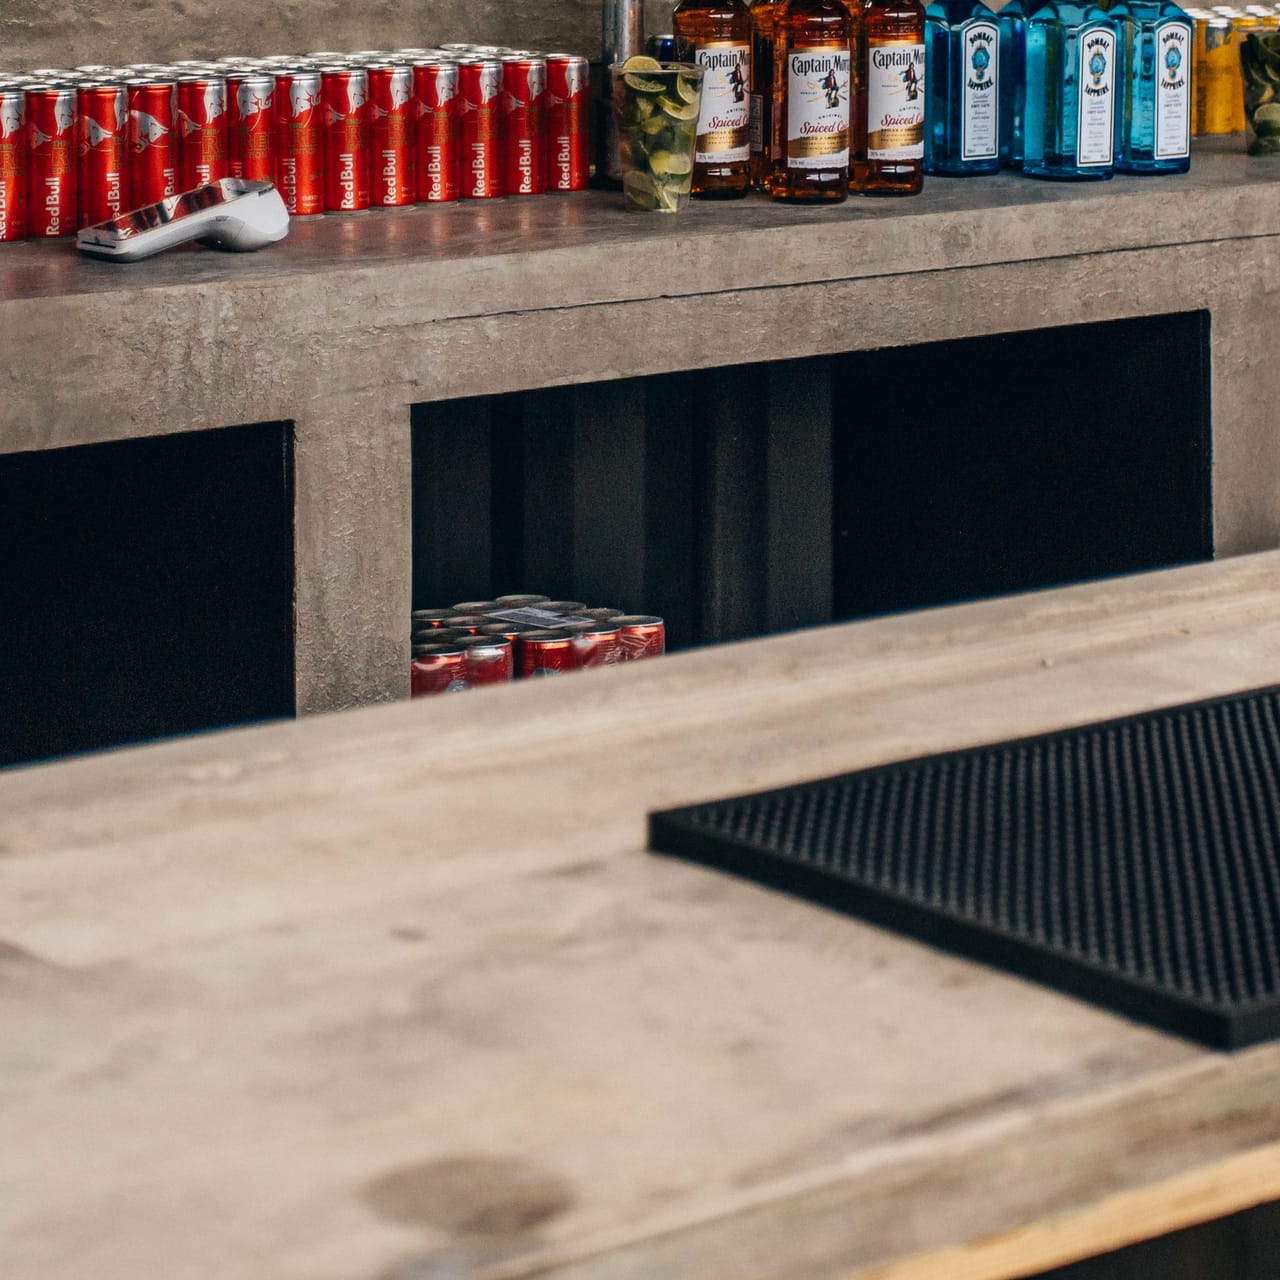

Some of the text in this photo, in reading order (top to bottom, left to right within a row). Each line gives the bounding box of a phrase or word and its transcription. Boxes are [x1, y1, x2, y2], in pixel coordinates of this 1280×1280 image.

[699, 51, 737, 71] Captain
[792, 56, 830, 76] Captain
[873, 49, 911, 70] Captain
[708, 116, 742, 129] Spiced
[800, 121, 836, 135] Spiced
[880, 114, 915, 127] Spiced
[231, 162, 242, 179] ull
[282, 158, 296, 185] Bull
[428, 146, 441, 200] Red Bull
[472, 143, 485, 197] Red Bull
[520, 140, 532, 193] Red Bull
[558, 136, 570, 189] Red Bull
[164, 168, 174, 196] Bull
[340, 154, 354, 209] Red Bull
[382, 150, 396, 204] Red Bull
[46, 177, 60, 236] Red Bull
[106, 173, 120, 220] ed Bull
